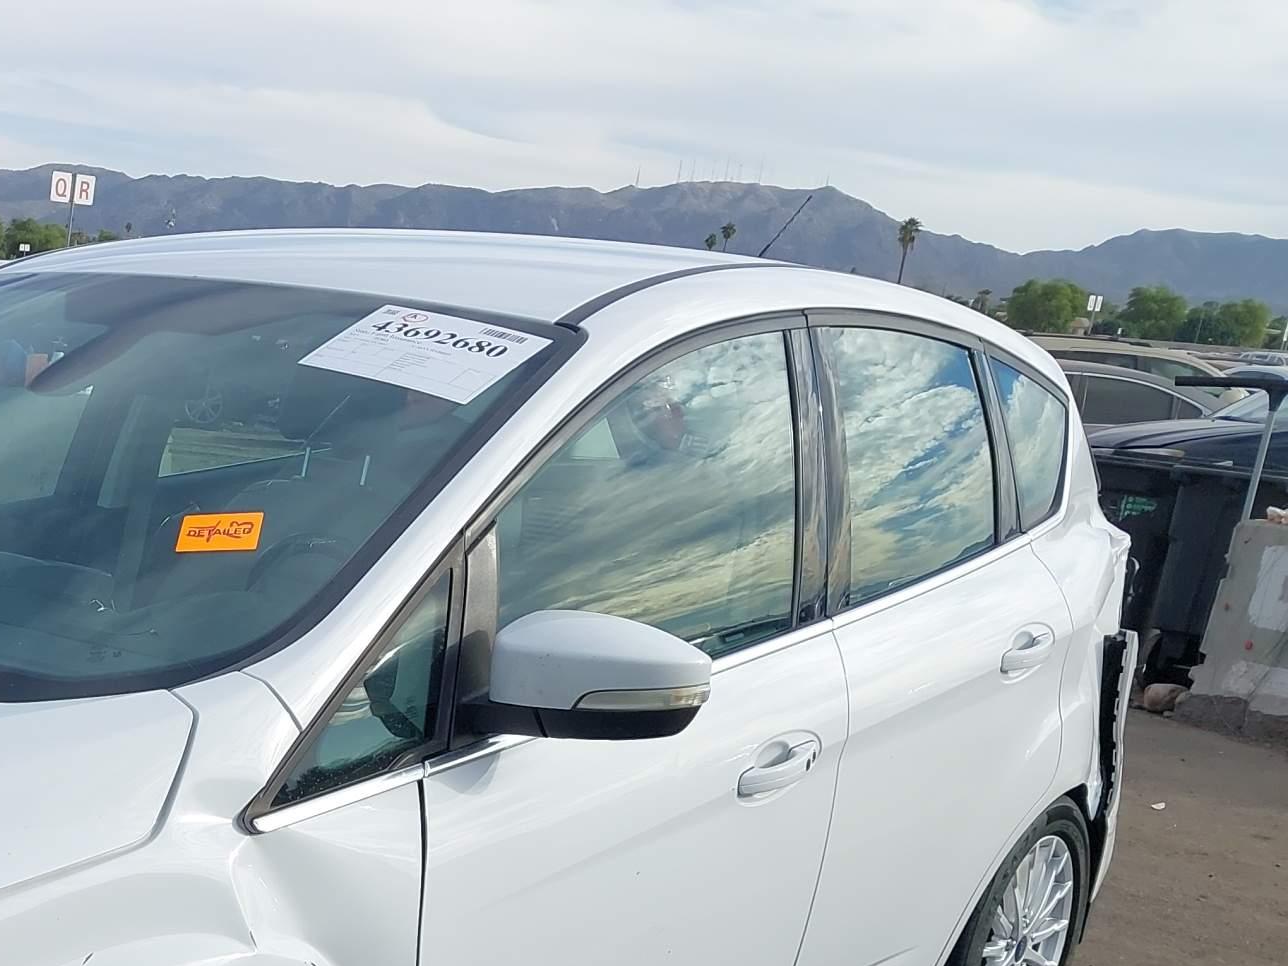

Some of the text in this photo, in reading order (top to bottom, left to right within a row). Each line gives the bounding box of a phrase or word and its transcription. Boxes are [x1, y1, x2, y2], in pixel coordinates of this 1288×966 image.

[55, 177, 67, 198] Q
[79, 180, 90, 201] R
[371, 320, 509, 358] 43692680
[186, 520, 254, 543] DETAILED
